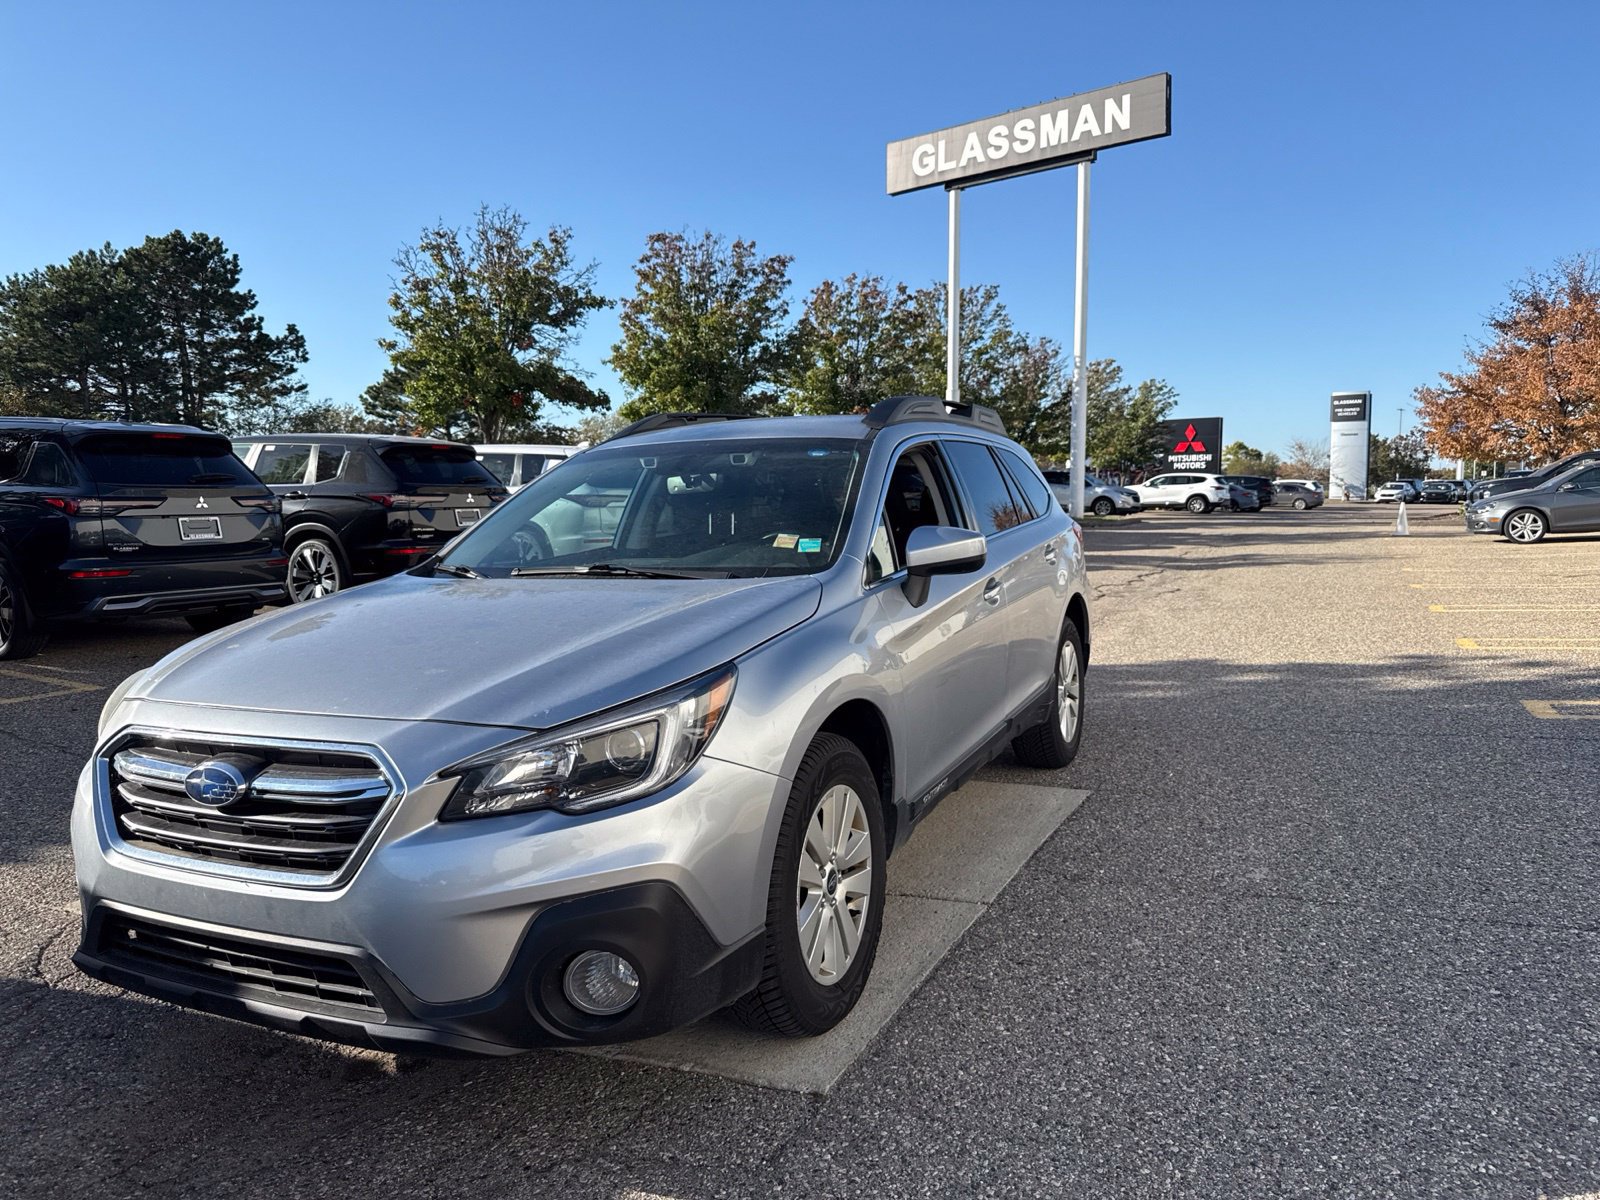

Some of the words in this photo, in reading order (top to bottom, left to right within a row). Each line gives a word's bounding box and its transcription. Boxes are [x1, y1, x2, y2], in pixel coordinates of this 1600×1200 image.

[912, 93, 1131, 177] GLASSMAN
[1168, 454, 1213, 463] MITSUBISHI
[1173, 462, 1207, 470] MOTORS
